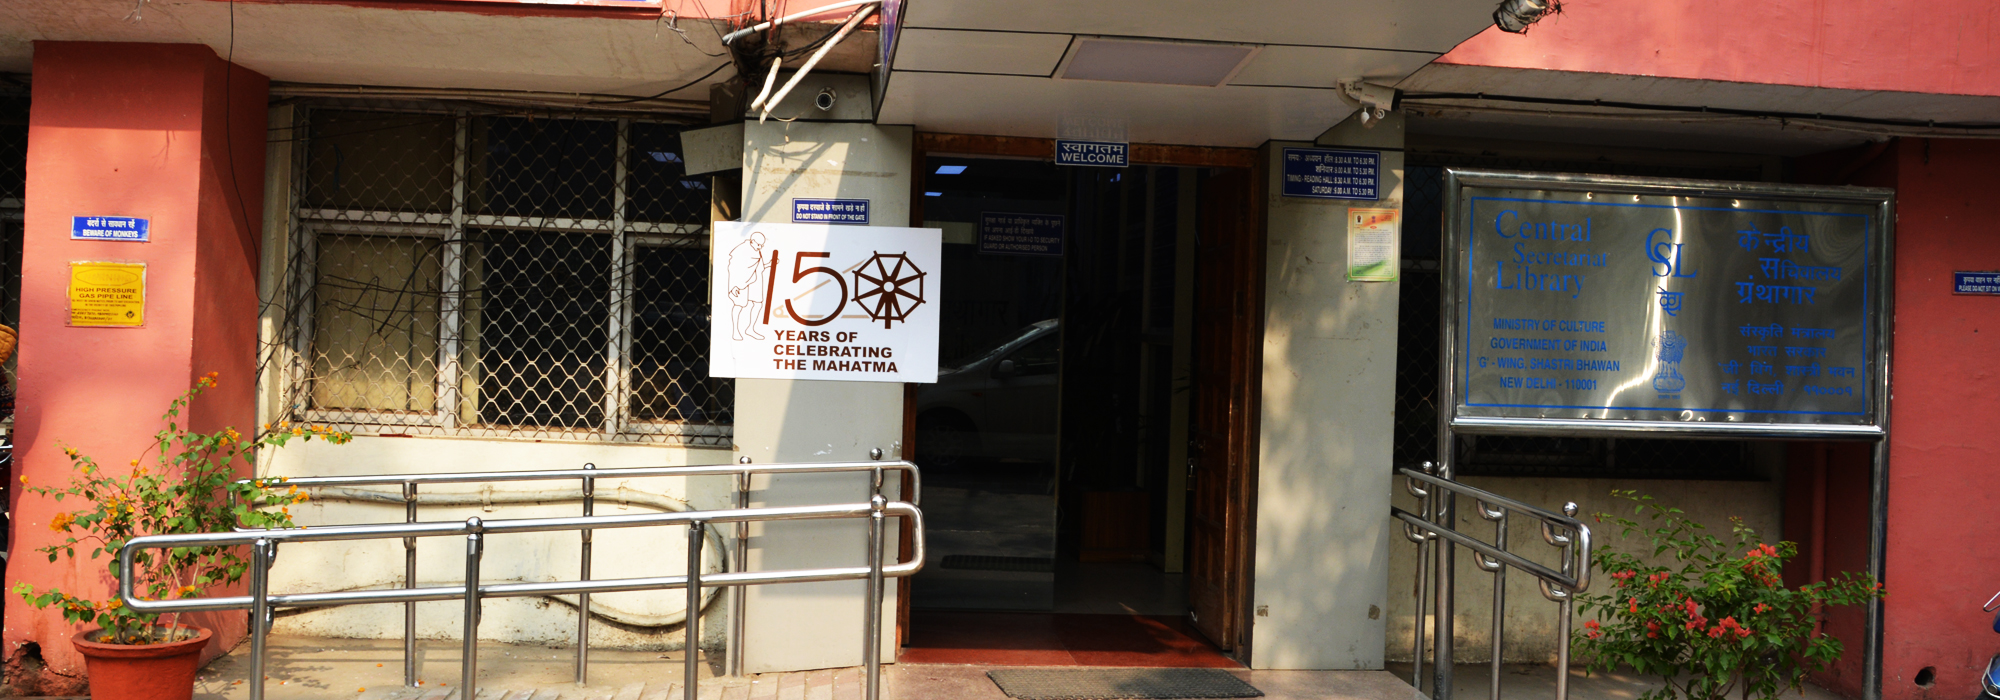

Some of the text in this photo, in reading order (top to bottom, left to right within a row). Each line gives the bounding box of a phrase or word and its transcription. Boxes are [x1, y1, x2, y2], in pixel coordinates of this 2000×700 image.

[1062, 142, 1124, 154] स्वागतम
[1061, 152, 1124, 164] WELCOME
[1312, 186, 1332, 194] SATURDAY
[825, 202, 831, 211] के
[1494, 210, 1592, 242] Central
[1736, 221, 1810, 253] केन्द्रीय
[1512, 242, 1607, 268] Secretariat
[1645, 227, 1698, 278] CSL
[1759, 258, 1842, 282] सचिवालय
[1494, 260, 1585, 299] Library
[1735, 274, 1817, 305] ग्रंथागार
[1493, 318, 1605, 333] MINISTRY OF CULTURE
[1739, 323, 1835, 342] संस्कृति मंत्रालय
[774, 329, 858, 343] YEARS OF
[774, 344, 893, 358] CELEBRATING
[1490, 338, 1607, 352] GOVERNMENT OF INDIA
[1748, 345, 1826, 358] भारत सरकार
[773, 359, 898, 373] THE MAHATMA
[1497, 358, 1527, 371] WING,
[1530, 358, 1574, 370] SHASTRI
[1576, 360, 1620, 371] BHAWAN
[1785, 362, 1820, 377] शास्त्री
[1828, 366, 1855, 378] भवन
[1500, 377, 1523, 388] NEW
[1526, 378, 1556, 390] DELHI
[1565, 378, 1597, 390] 110001
[1721, 379, 1739, 396] नई
[1747, 380, 1784, 395] दिल्ली
